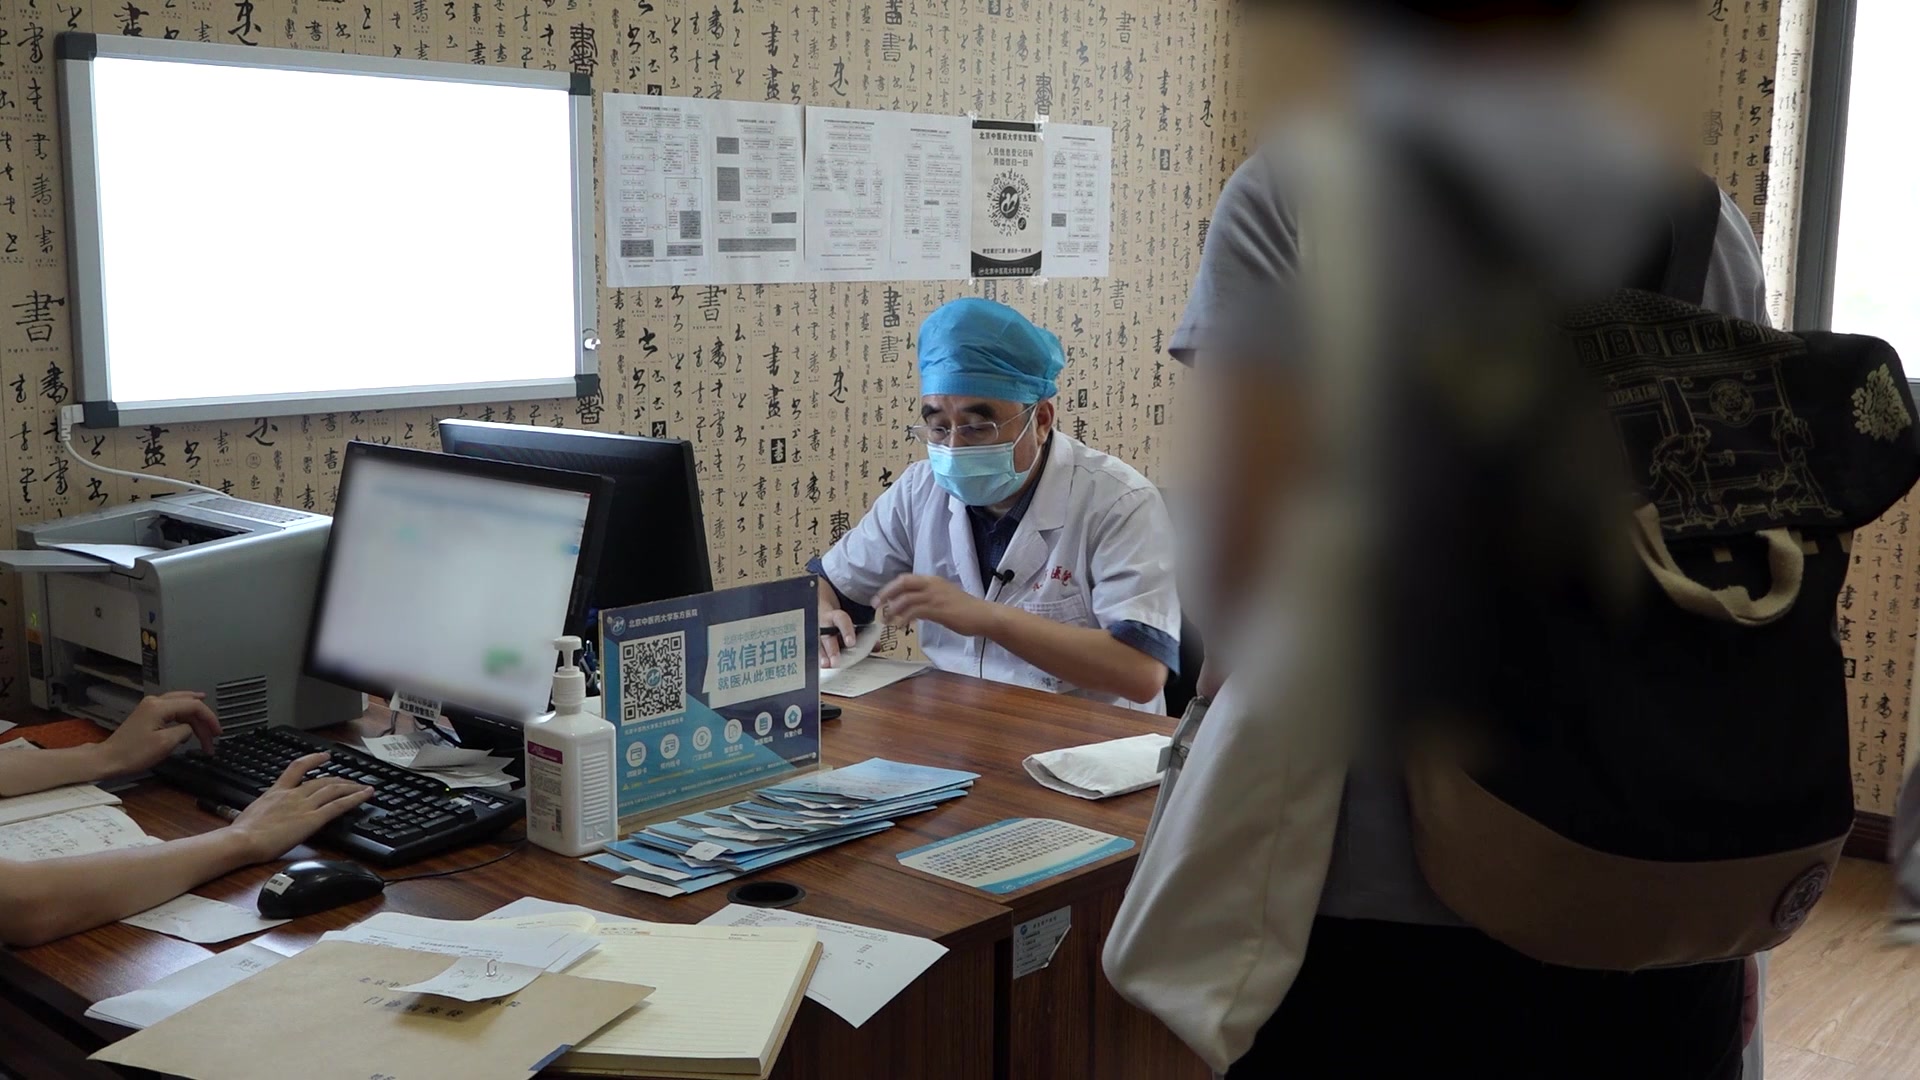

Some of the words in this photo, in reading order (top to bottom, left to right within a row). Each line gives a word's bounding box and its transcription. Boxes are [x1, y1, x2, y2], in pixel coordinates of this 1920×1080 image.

[628, 608, 699, 629] 北京中医药大学东方医院
[716, 635, 798, 675] 微信扫码
[717, 661, 798, 692] 就医从此更轻松
